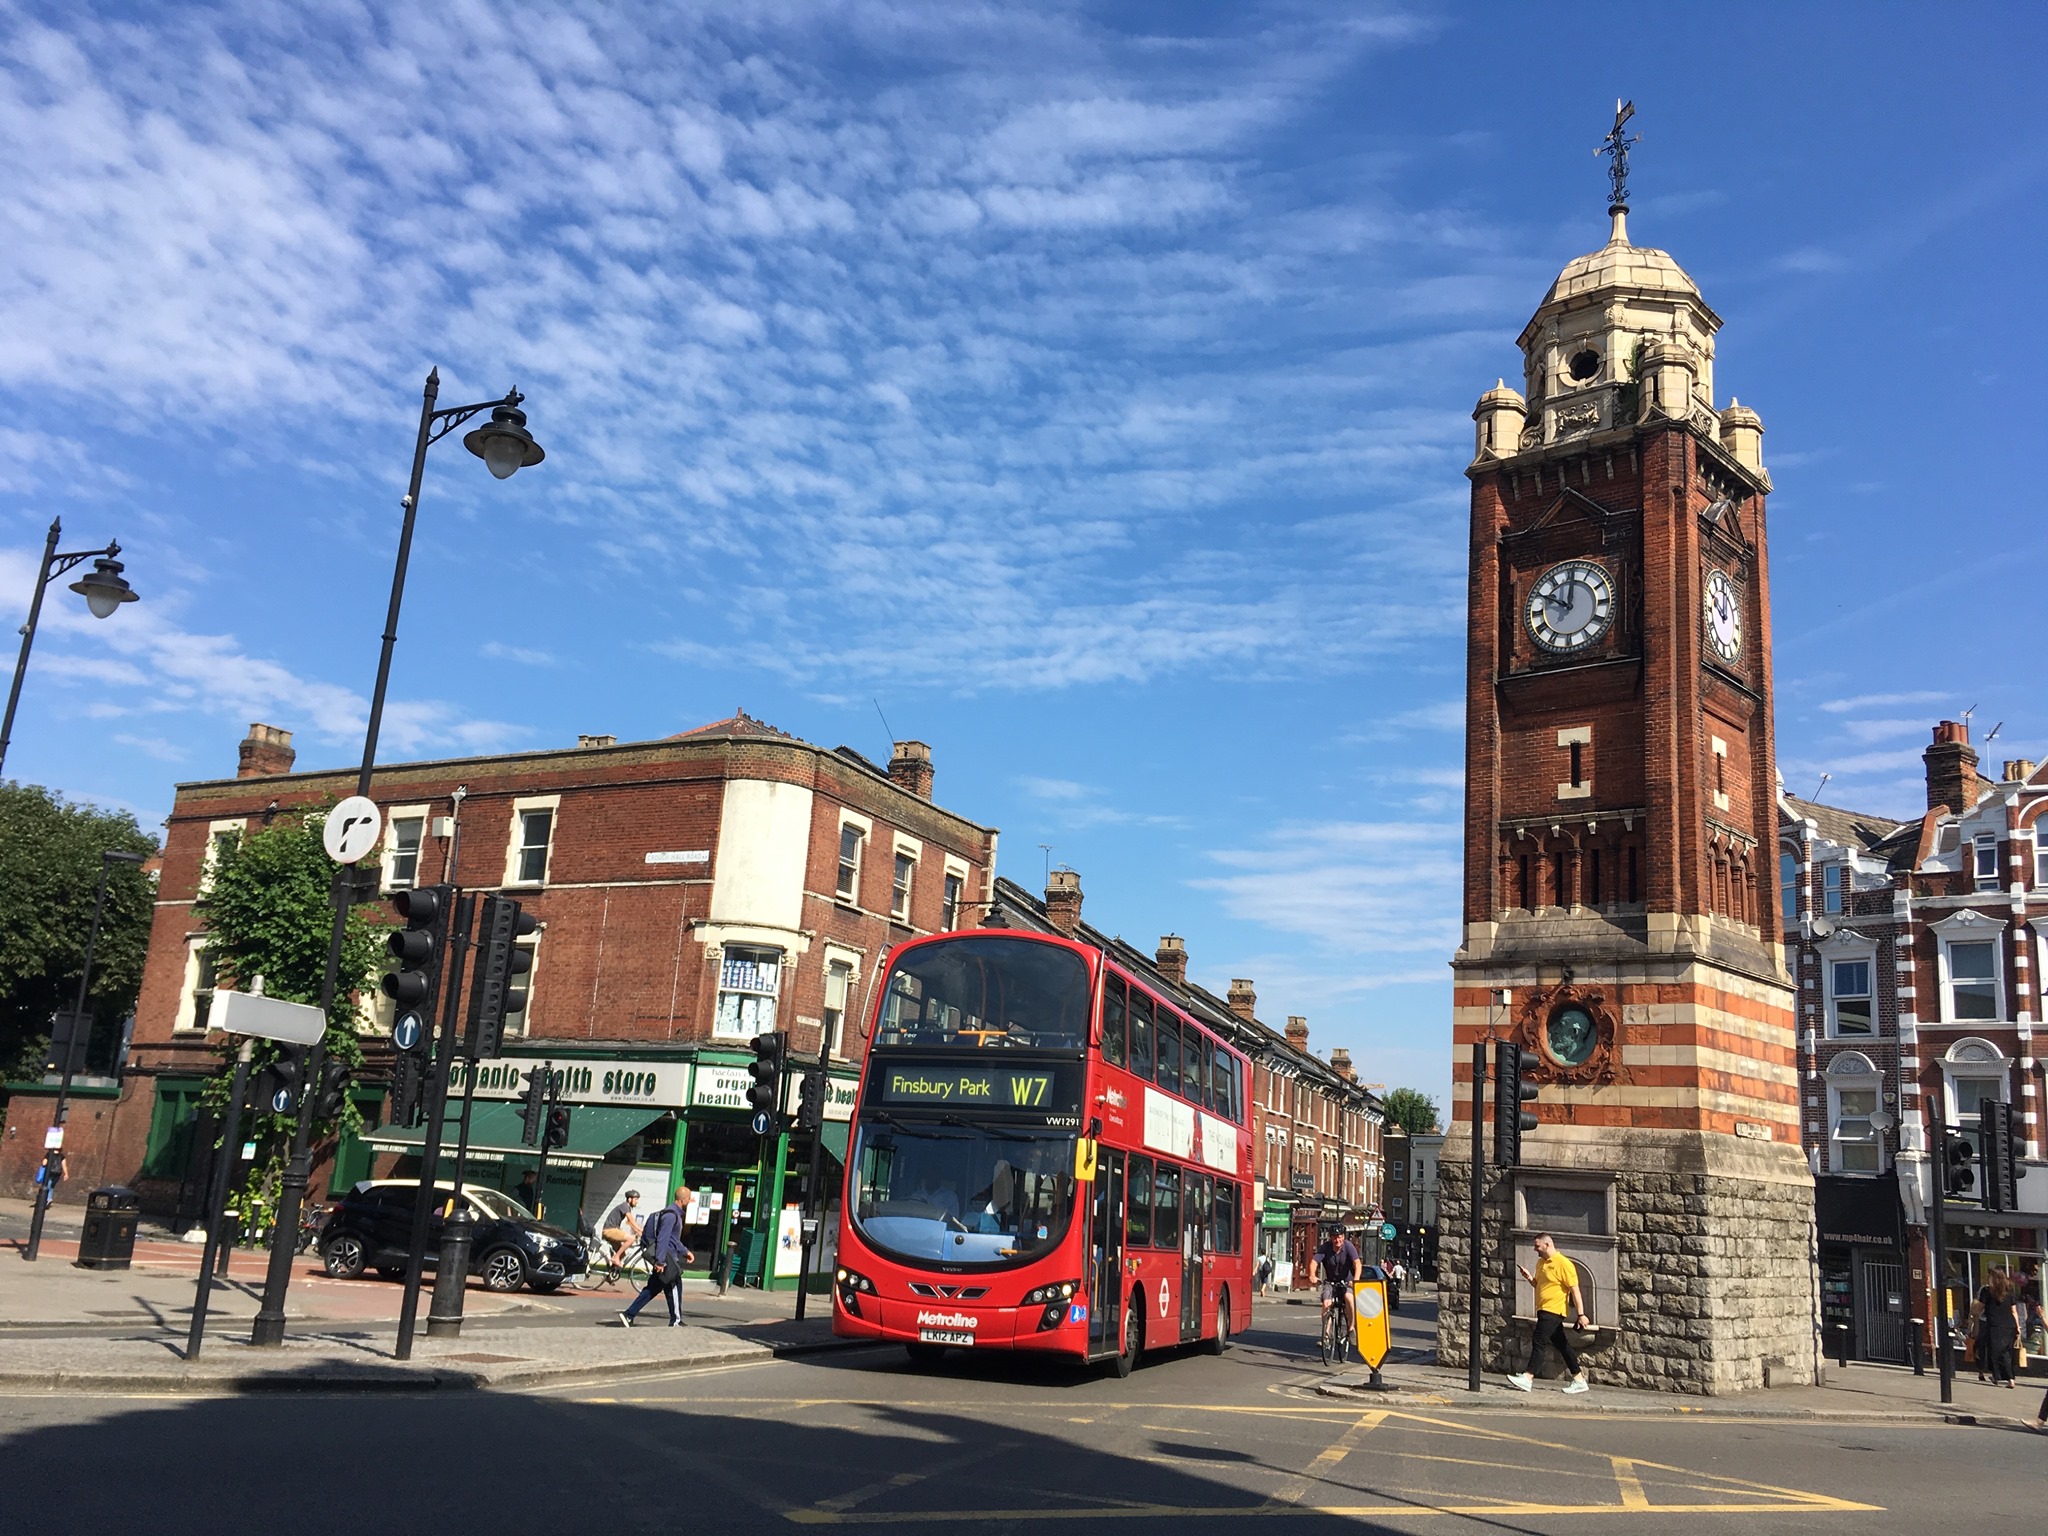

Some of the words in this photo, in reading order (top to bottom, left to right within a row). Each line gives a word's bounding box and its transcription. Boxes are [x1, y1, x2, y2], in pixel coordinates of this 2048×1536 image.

[686, 852, 702, 860] ROAD
[602, 1069, 657, 1097] store
[716, 1078, 758, 1091] organ
[835, 1086, 858, 1106] heal
[892, 1076, 953, 1099] Finsbury
[959, 1077, 990, 1096] Park
[1011, 1077, 1048, 1106] W7
[698, 1091, 741, 1106] health
[1046, 1116, 1079, 1127] VW1291
[1823, 1232, 1893, 1245] www.mp4hair.co.uk
[917, 1310, 978, 1328] Metroline
[926, 1332, 947, 1342] LK12
[949, 1333, 968, 1343] APZ
